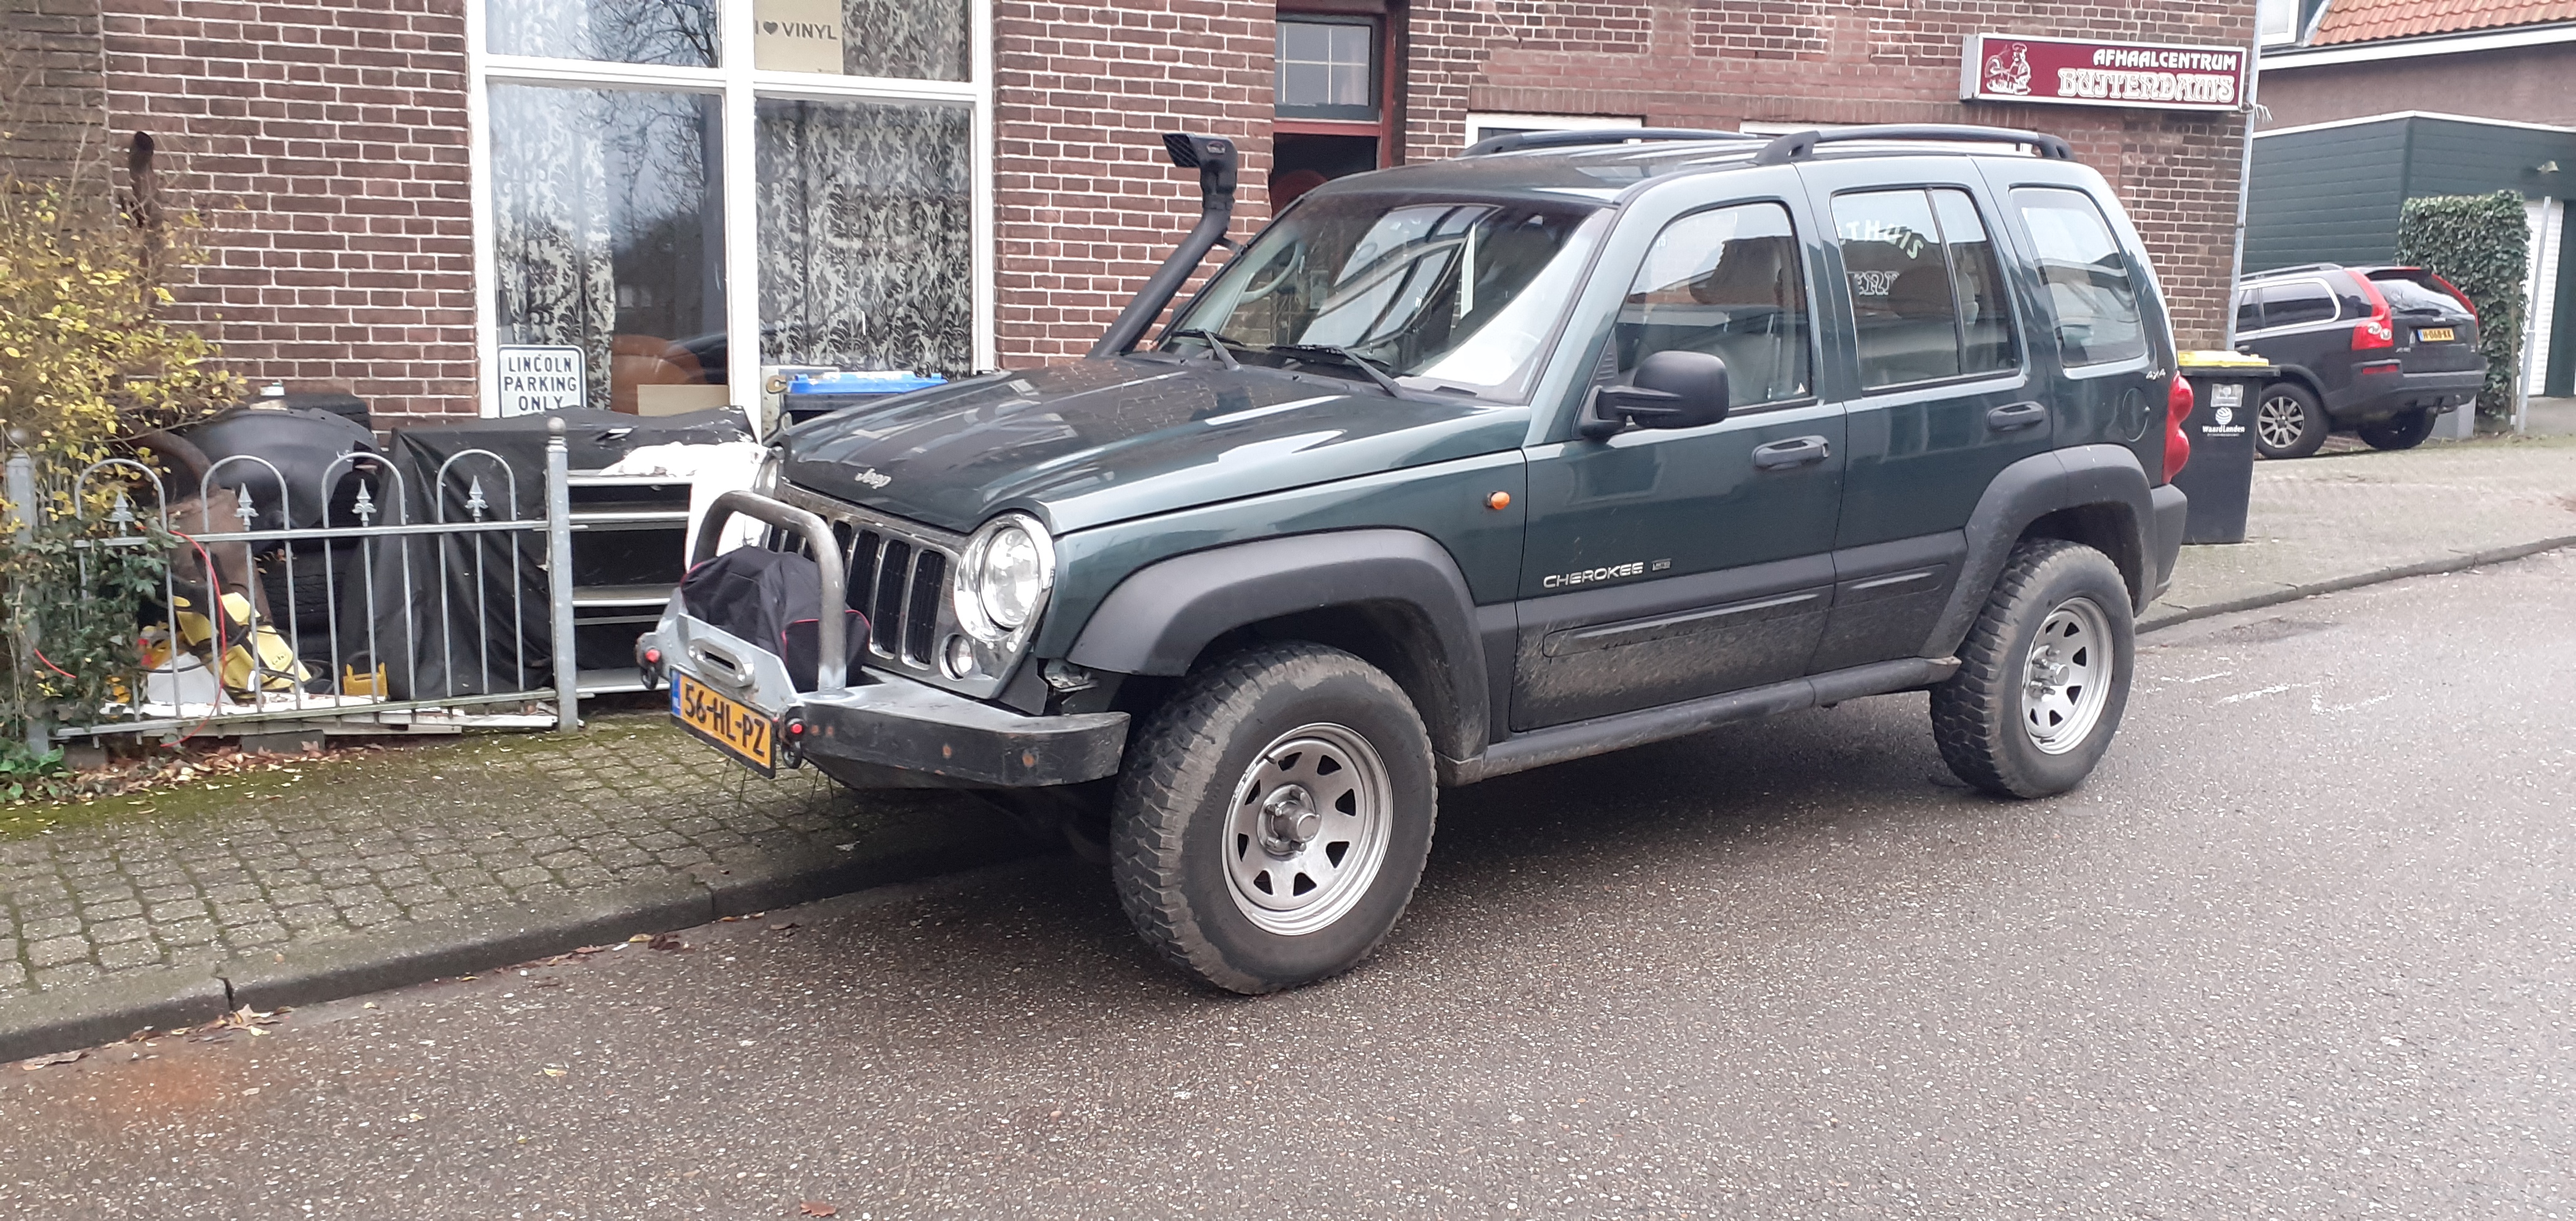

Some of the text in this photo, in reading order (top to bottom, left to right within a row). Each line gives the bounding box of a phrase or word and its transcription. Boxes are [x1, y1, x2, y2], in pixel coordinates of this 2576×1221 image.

[755, 21, 837, 40] I VINYL
[2093, 49, 2237, 71] AFHAALCENTRUM
[508, 356, 572, 373] LINCOLN
[504, 376, 577, 392] PARKING
[518, 395, 564, 411] ONLY
[854, 468, 892, 489] Jeep
[1543, 562, 1644, 588] CHEROKEE
[685, 682, 765, 757] 56-HL-PZ
